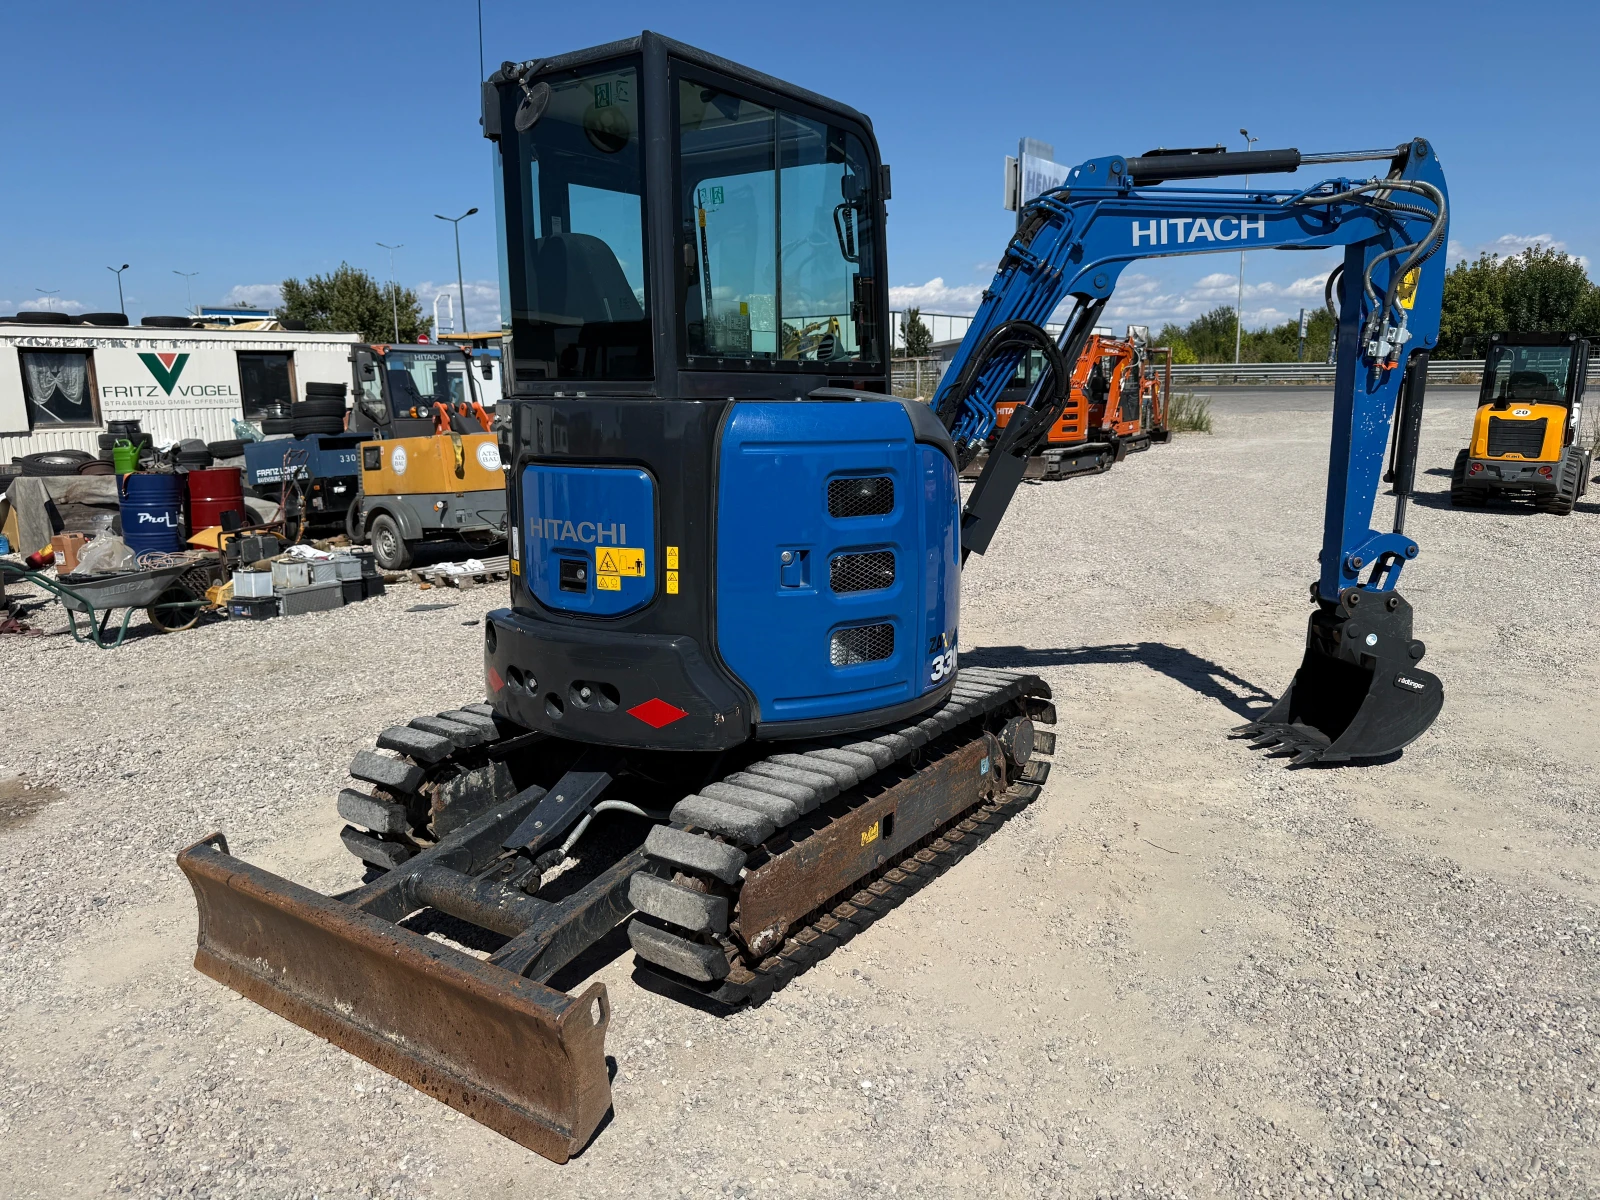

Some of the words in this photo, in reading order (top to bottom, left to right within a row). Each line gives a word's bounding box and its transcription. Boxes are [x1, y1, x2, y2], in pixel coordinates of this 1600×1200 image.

[1132, 214, 1265, 247] HITACH
[102, 386, 159, 397] FRITZ
[178, 385, 238, 397] VOGEL
[340, 453, 357, 463] 330
[256, 467, 279, 477] FRANZ
[530, 517, 627, 545] HITACHI
